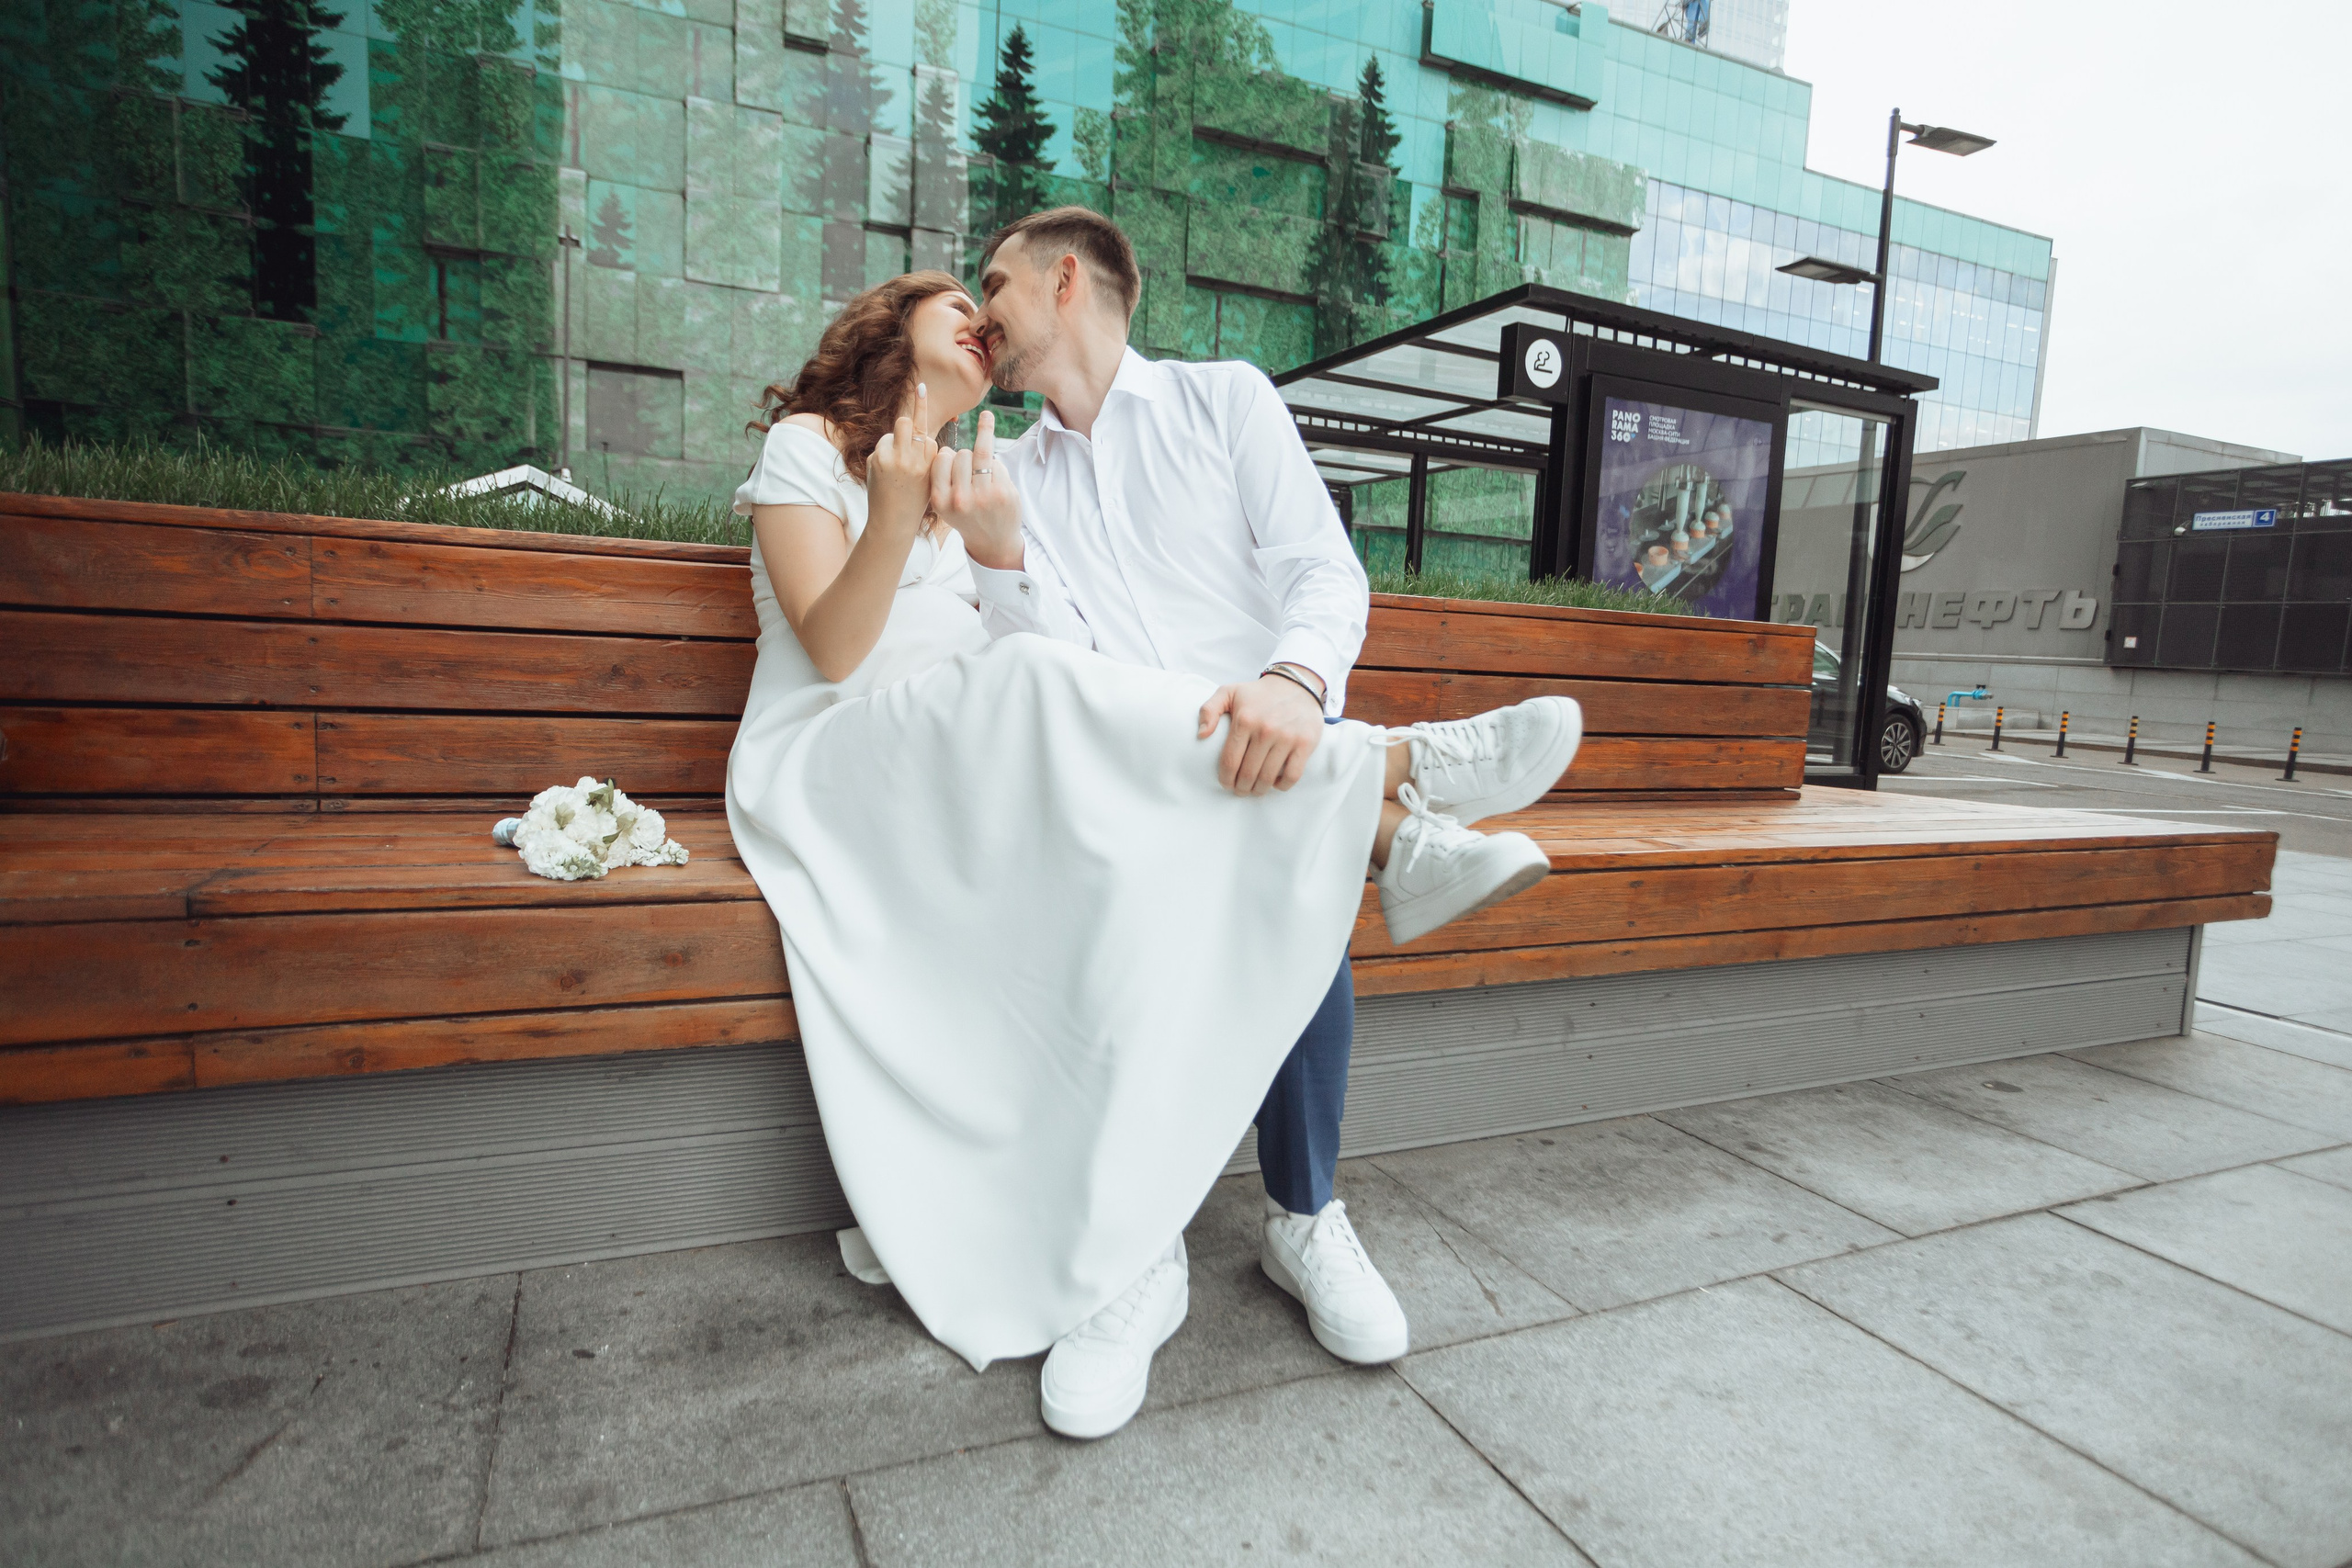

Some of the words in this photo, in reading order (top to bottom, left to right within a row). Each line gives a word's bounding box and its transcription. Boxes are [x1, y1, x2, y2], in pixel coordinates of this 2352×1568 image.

[1612, 410, 1641, 423] PANO
[1649, 415, 1677, 424] СМОТРОВАЯ
[1611, 420, 1638, 433] RAMA
[1648, 422, 1675, 430] ПЛОЩАДКА
[1648, 428, 1680, 437] МОСКВА-СИТИ
[1664, 436, 1690, 445] ФЕДЕРАЦИЯ
[2260, 512, 2270, 522] 4
